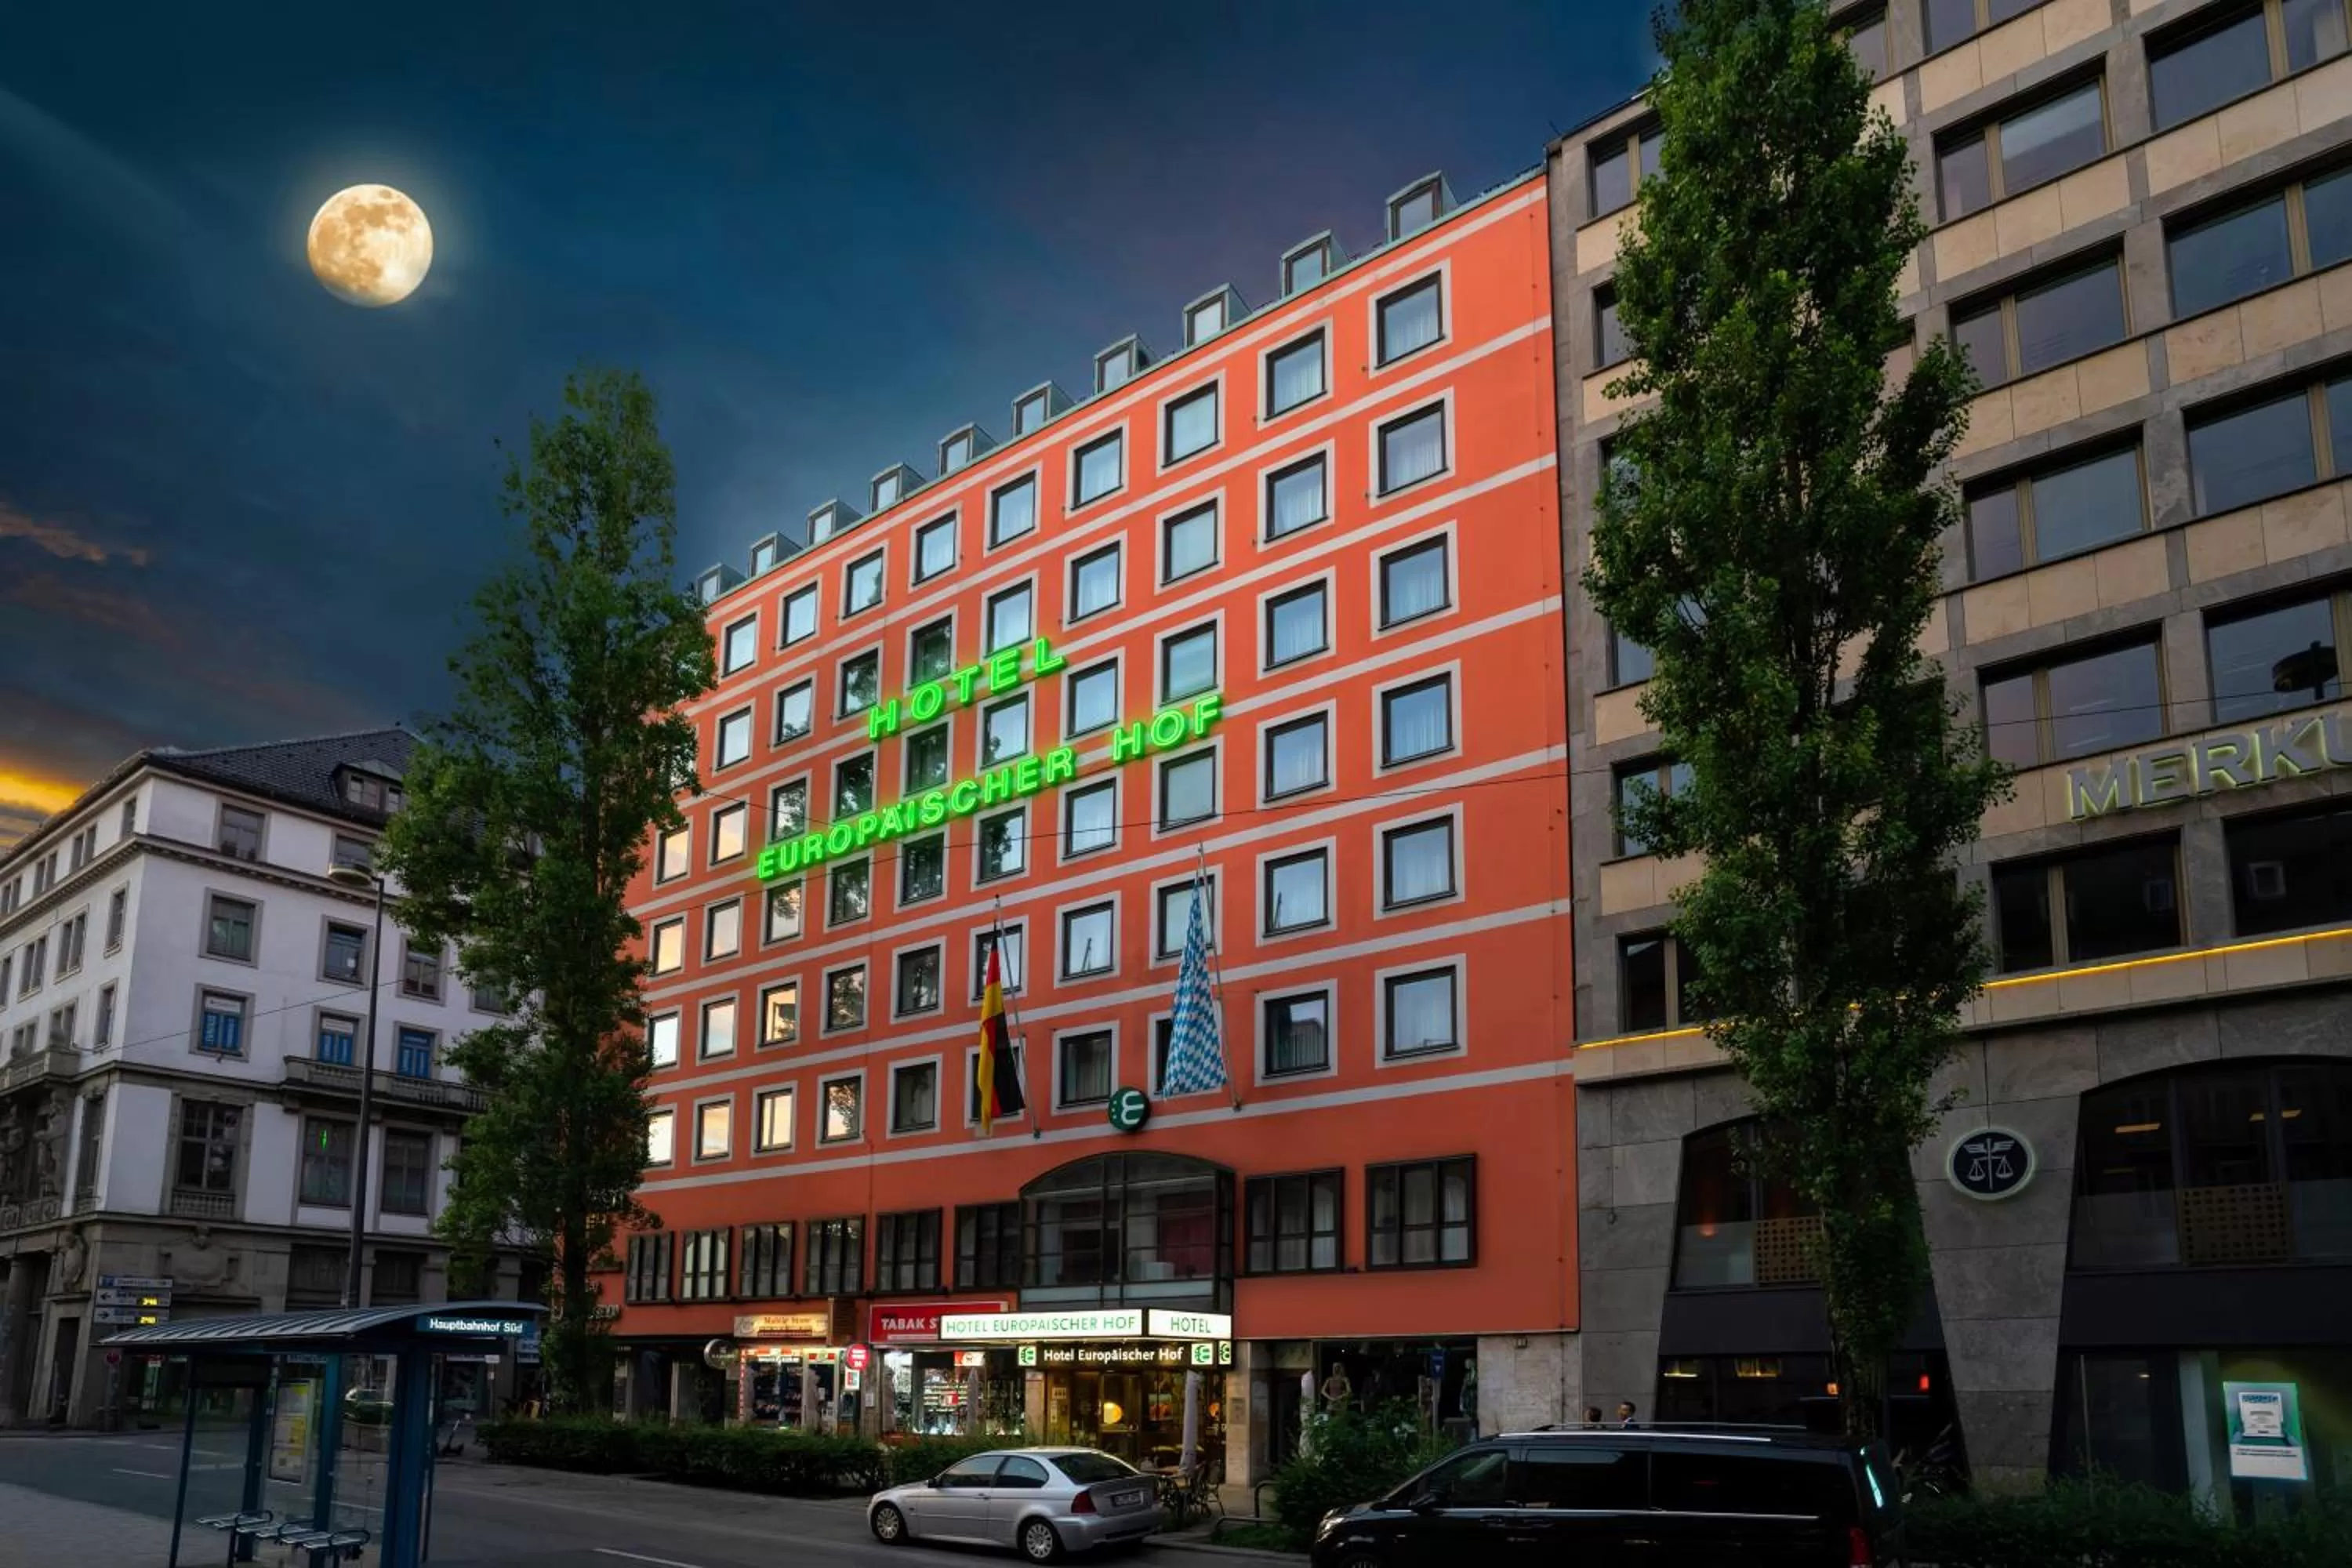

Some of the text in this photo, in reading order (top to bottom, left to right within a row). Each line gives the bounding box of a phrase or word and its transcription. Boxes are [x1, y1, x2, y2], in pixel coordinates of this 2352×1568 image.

[868, 637, 1066, 741] HOTEL
[757, 695, 1223, 880] EUROPÄISCHER HOF
[429, 1317, 523, 1334] Hauptbahnhof Süd
[880, 1316, 939, 1330] TABAK S
[946, 1319, 989, 1333] HOTEL
[1103, 1316, 1136, 1330] HOF
[1171, 1316, 1211, 1334] HOTEL
[1044, 1346, 1185, 1364] Hotel Europäischer Hof
